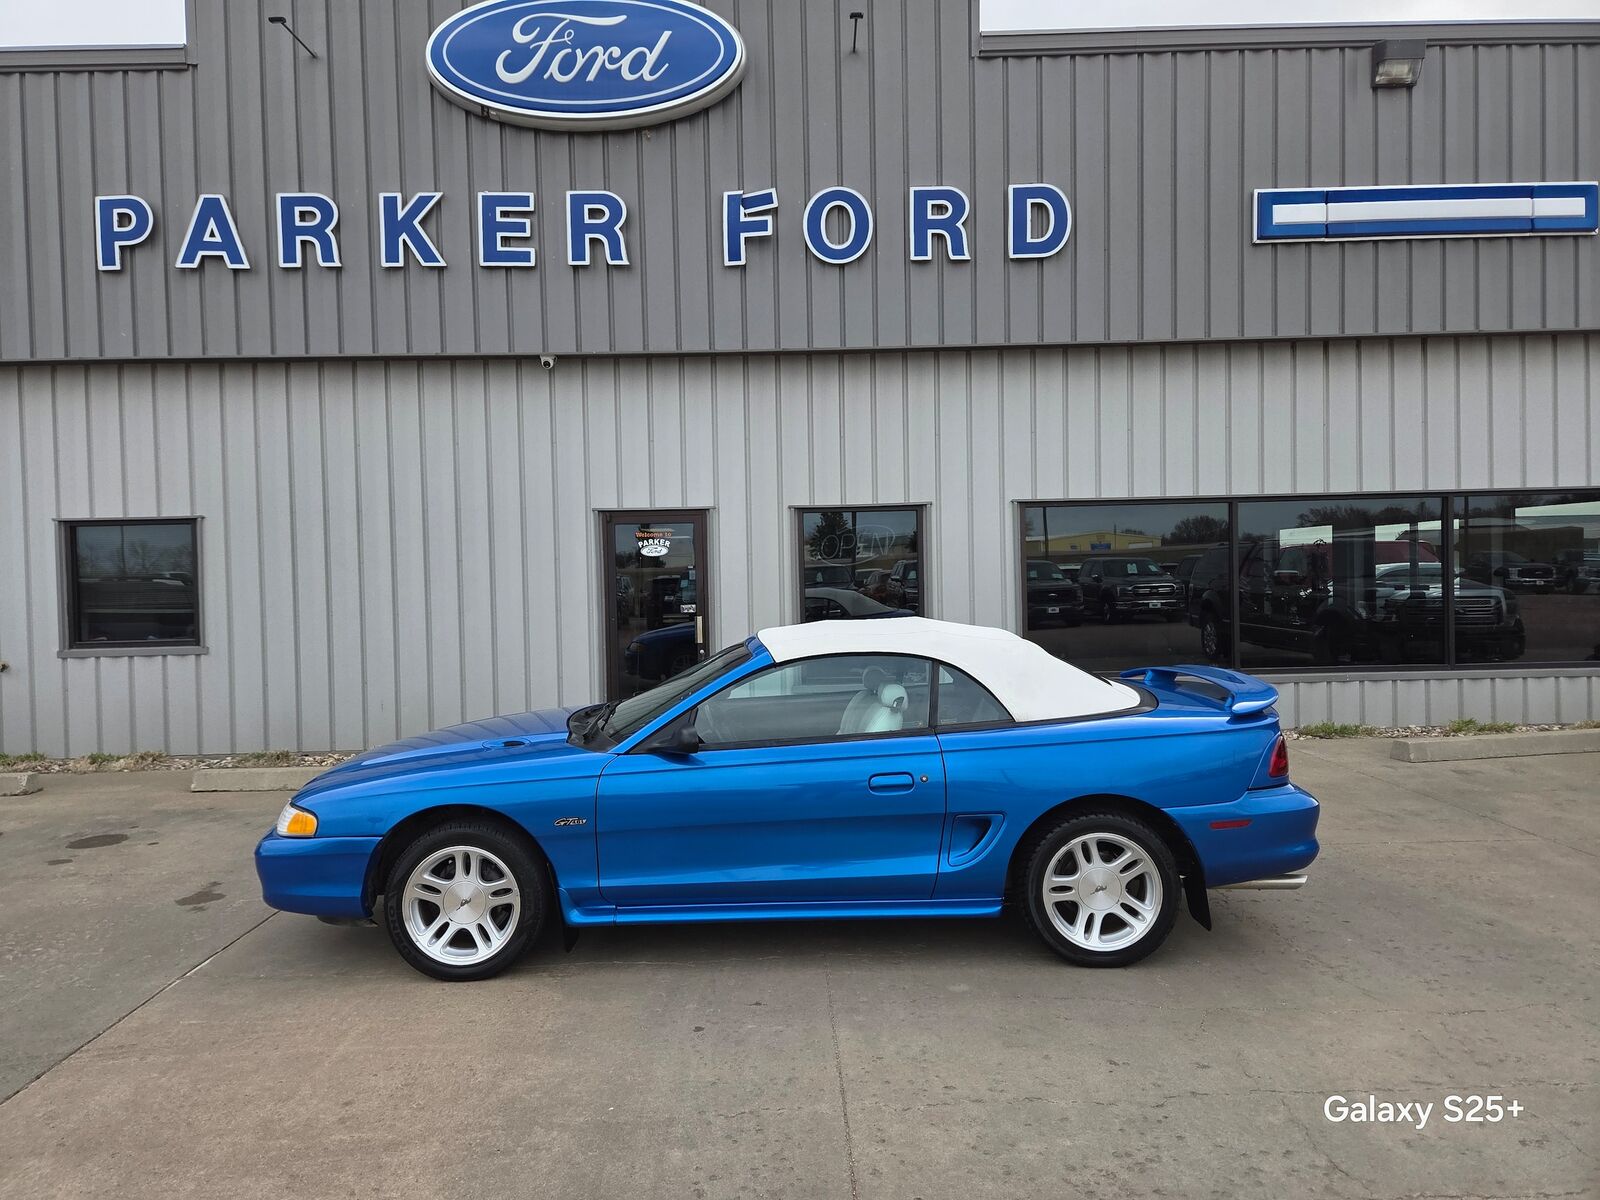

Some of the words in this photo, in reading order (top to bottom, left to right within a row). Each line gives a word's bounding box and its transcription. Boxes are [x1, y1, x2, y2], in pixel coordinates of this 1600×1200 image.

[495, 12, 673, 84] Ford
[95, 189, 630, 272] PARKER
[723, 182, 1073, 266] FORD
[638, 538, 671, 549] PARKER
[820, 532, 890, 559] OPEN
